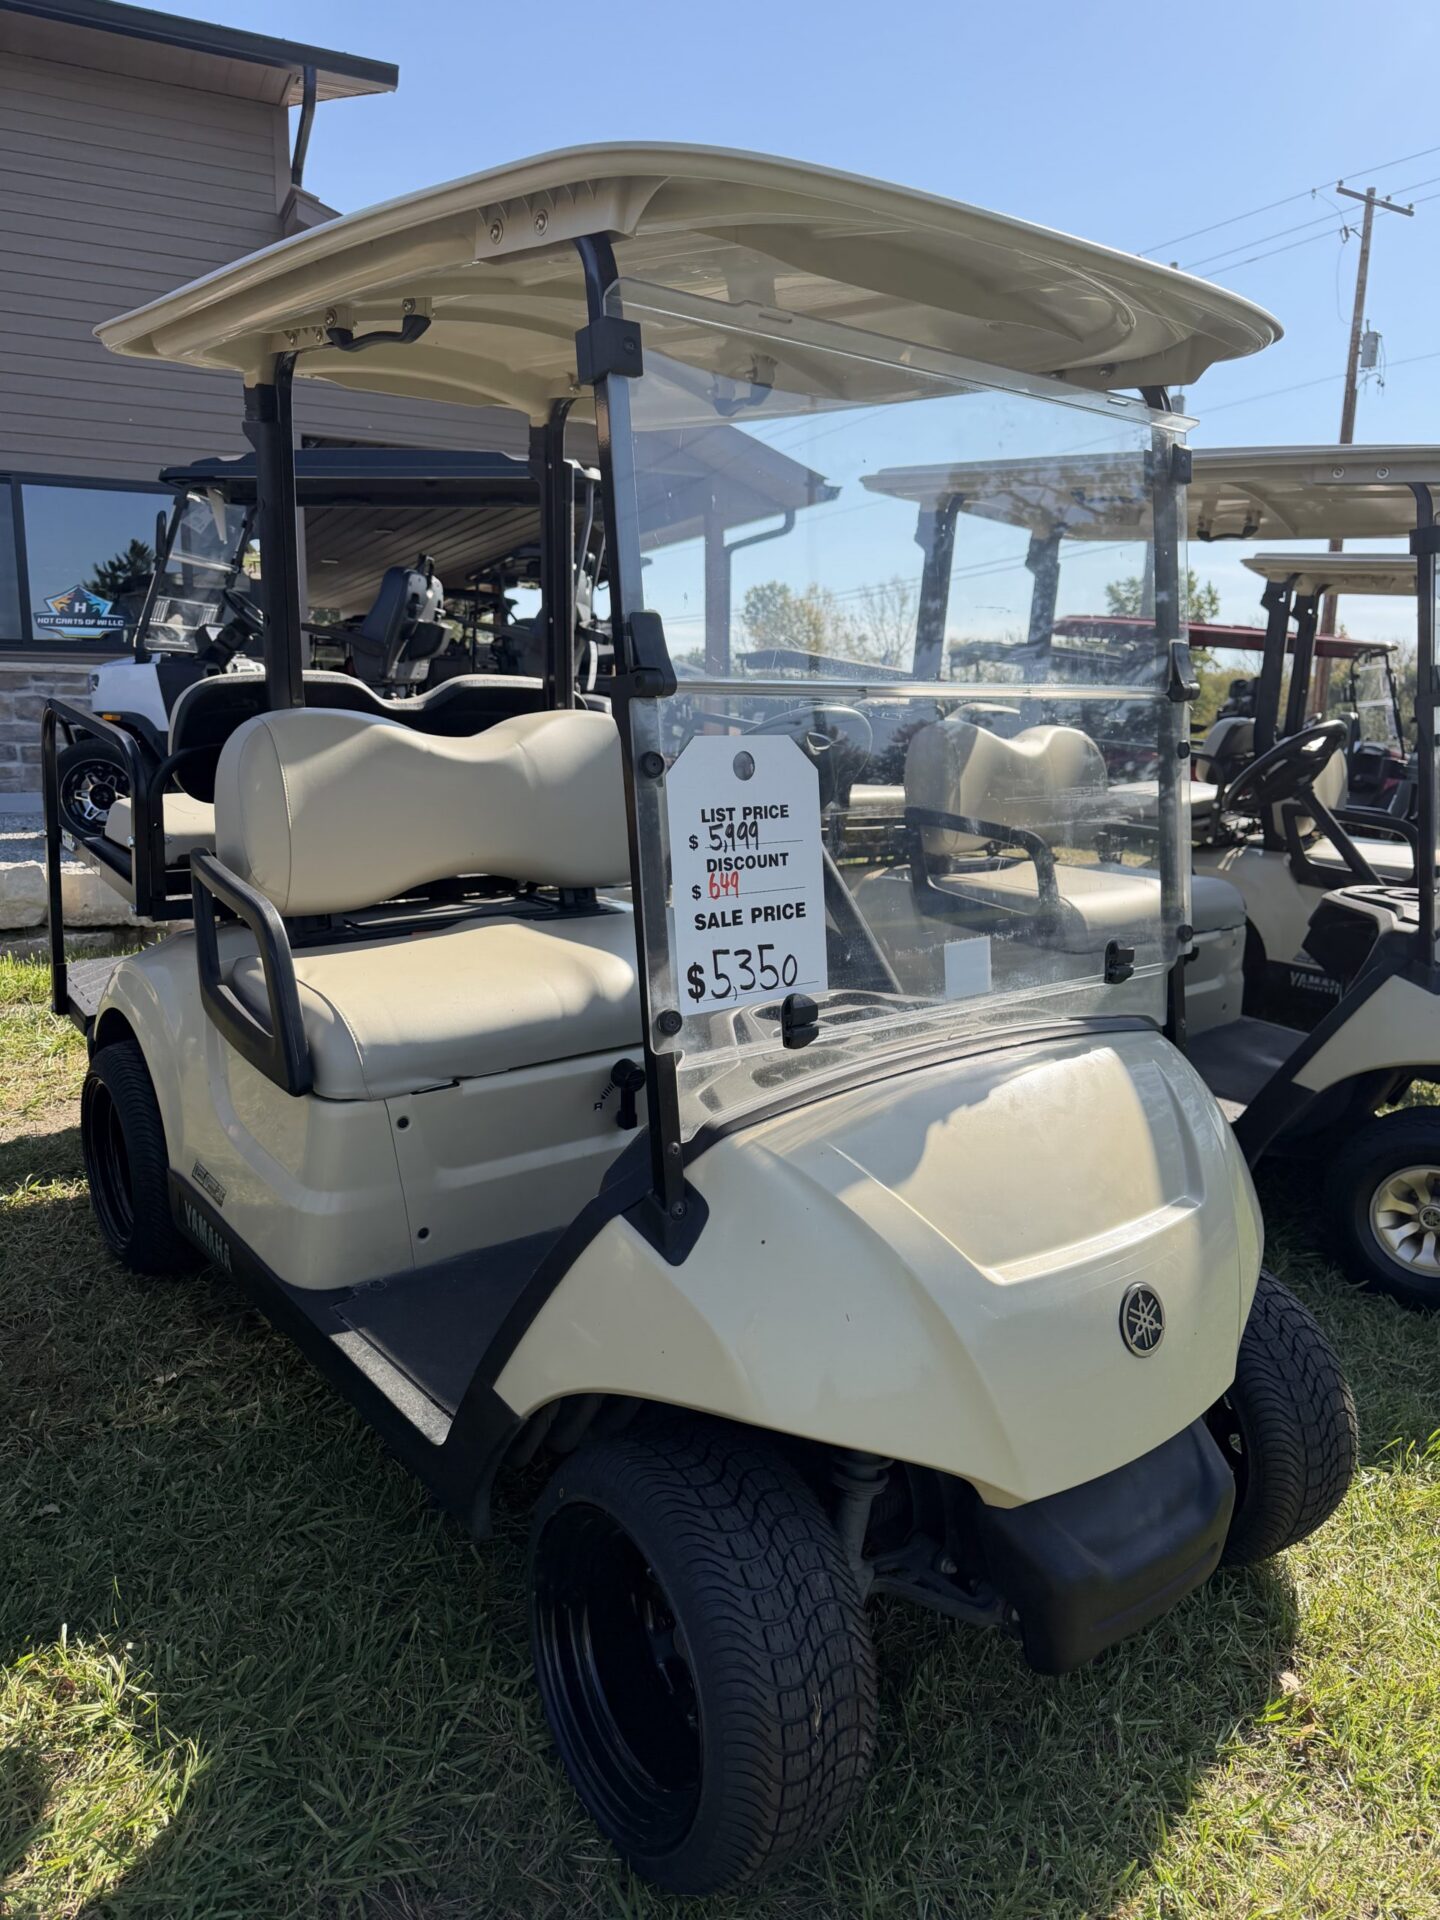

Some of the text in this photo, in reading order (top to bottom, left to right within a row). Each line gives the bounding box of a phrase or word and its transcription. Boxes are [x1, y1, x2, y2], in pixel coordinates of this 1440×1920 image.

[74, 602, 87, 613] H
[701, 804, 790, 823] LIST PRICE
[688, 820, 759, 853] $ 5,999
[706, 852, 789, 873] DISCOUNT
[691, 871, 739, 901] $ 649
[694, 902, 807, 931] SALE PRICE
[184, 1199, 233, 1273] YAMAHA
